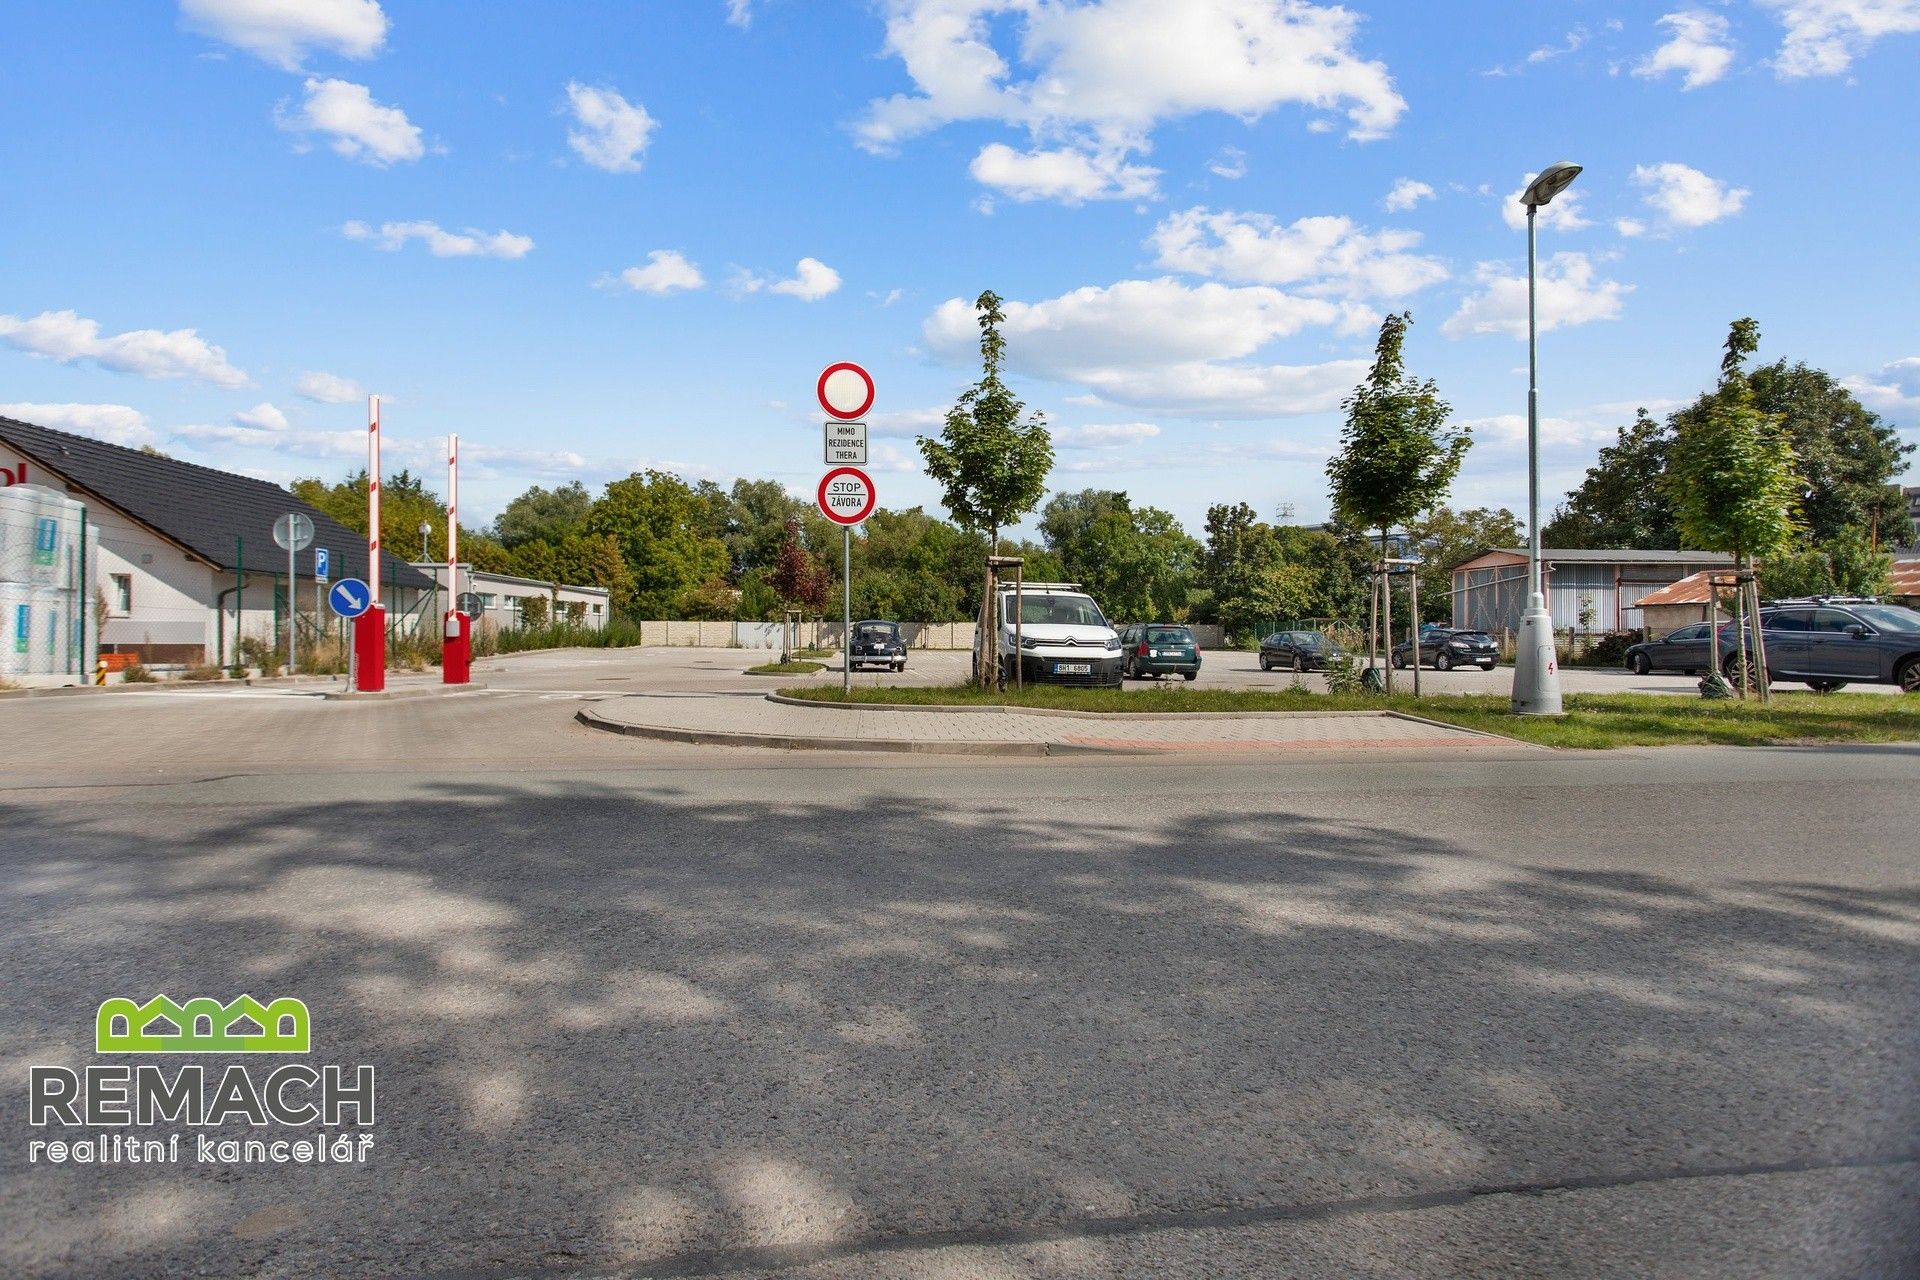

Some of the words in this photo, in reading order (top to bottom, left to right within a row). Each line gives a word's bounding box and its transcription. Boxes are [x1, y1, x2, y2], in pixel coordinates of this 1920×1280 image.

[837, 427, 855, 435] MIMO
[828, 439, 864, 448] REZIDENCE
[836, 451, 857, 460] THERA
[833, 482, 861, 492] STOP
[831, 496, 862, 507] ZÁVORA
[318, 552, 326, 568] P
